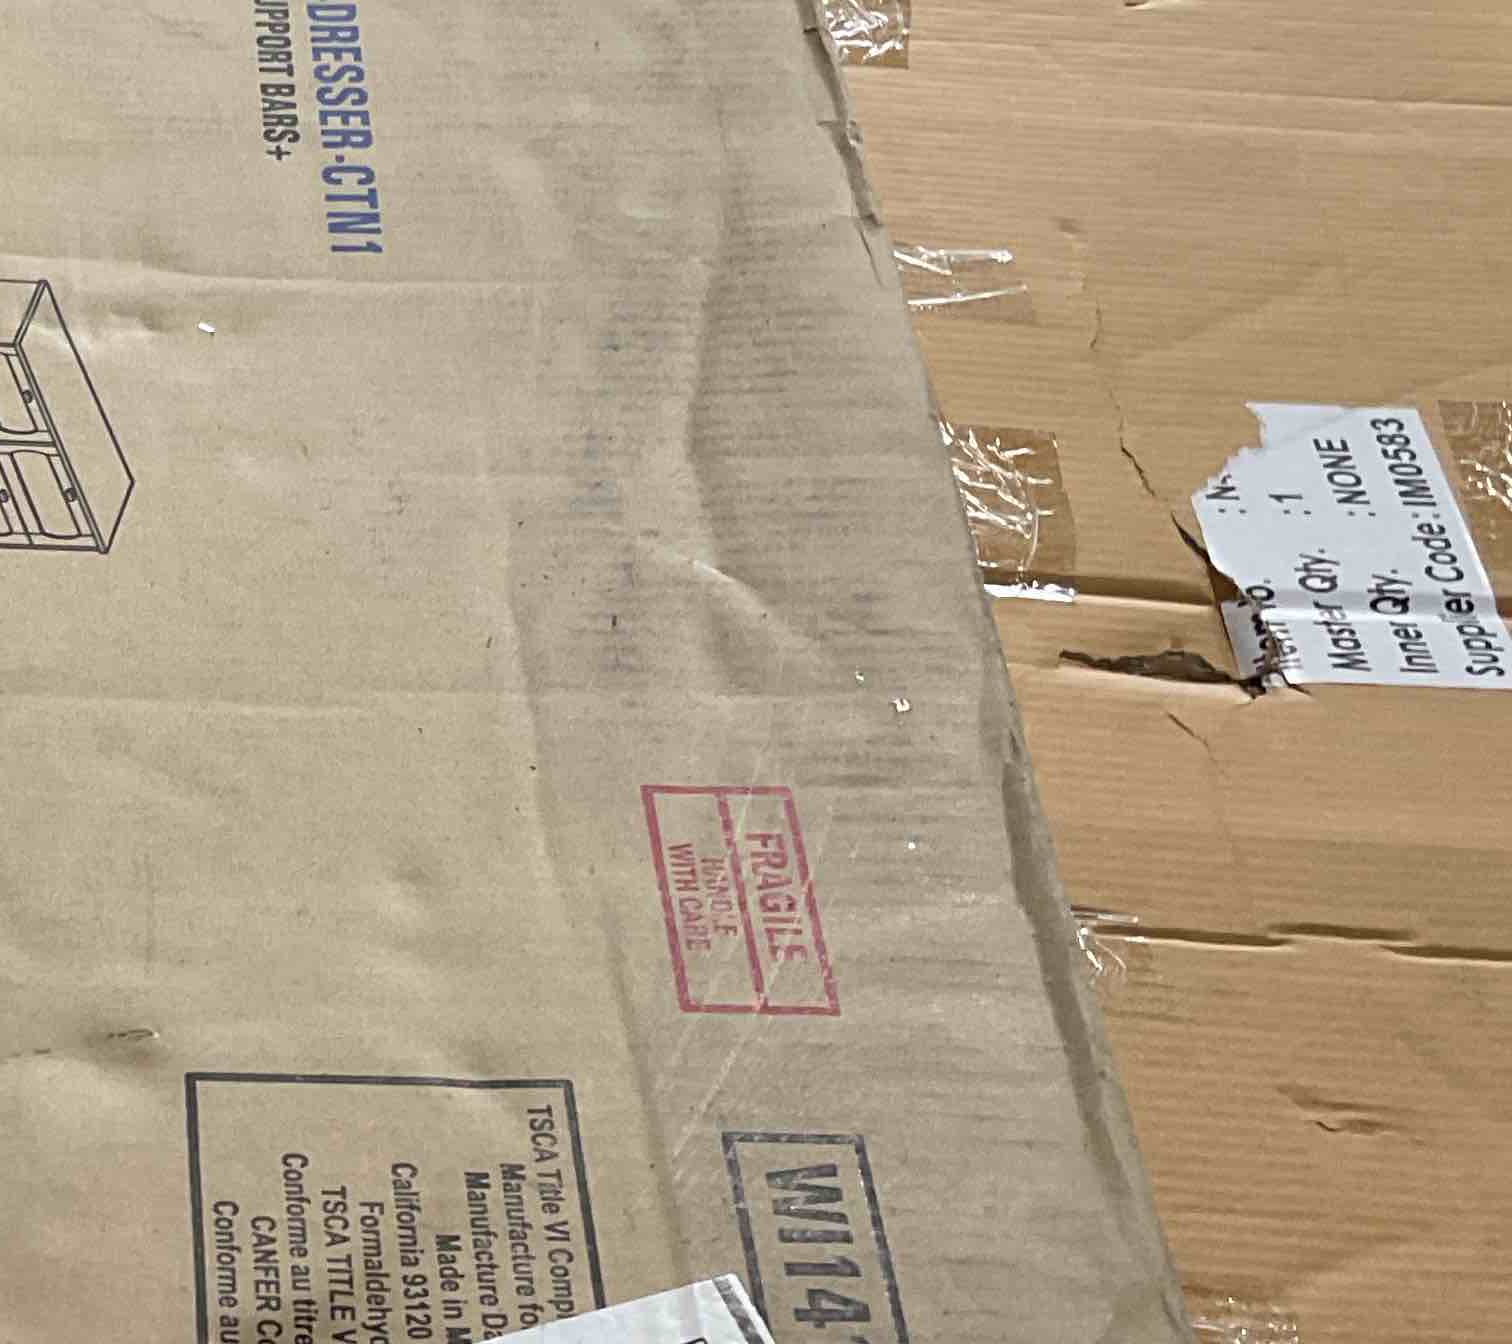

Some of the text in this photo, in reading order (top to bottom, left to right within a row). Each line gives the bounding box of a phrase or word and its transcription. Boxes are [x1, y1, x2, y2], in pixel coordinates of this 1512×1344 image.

[261, 83, 300, 162] BARS+
[1294, 548, 1340, 593] Qty.
[1367, 569, 1413, 615] Qty.
[1313, 600, 1372, 674] Master
[1380, 621, 1440, 674] Inner
[668, 843, 711, 951] WITH CARE
[745, 832, 808, 960] FRAGILE
[527, 1105, 559, 1163] TSCA
[281, 1153, 310, 1258] Conforme
[321, 1186, 351, 1247] TSCA
[391, 1162, 425, 1268] California
[537, 1168, 563, 1214] Title
[213, 1200, 238, 1308] Conforme
[250, 1216, 280, 1311] CANFER
[435, 1233, 464, 1292] Made
[464, 1171, 498, 1306] Manufacture
[482, 1313, 508, 1341] Da
[499, 1163, 544, 1330] Manufacture fo
[545, 1219, 570, 1242] VI
[291, 1264, 311, 1291] au
[326, 1255, 356, 1321] TITLE
[402, 1275, 433, 1341] 93120
[442, 1299, 469, 1320] in
[218, 1313, 239, 1342] au
